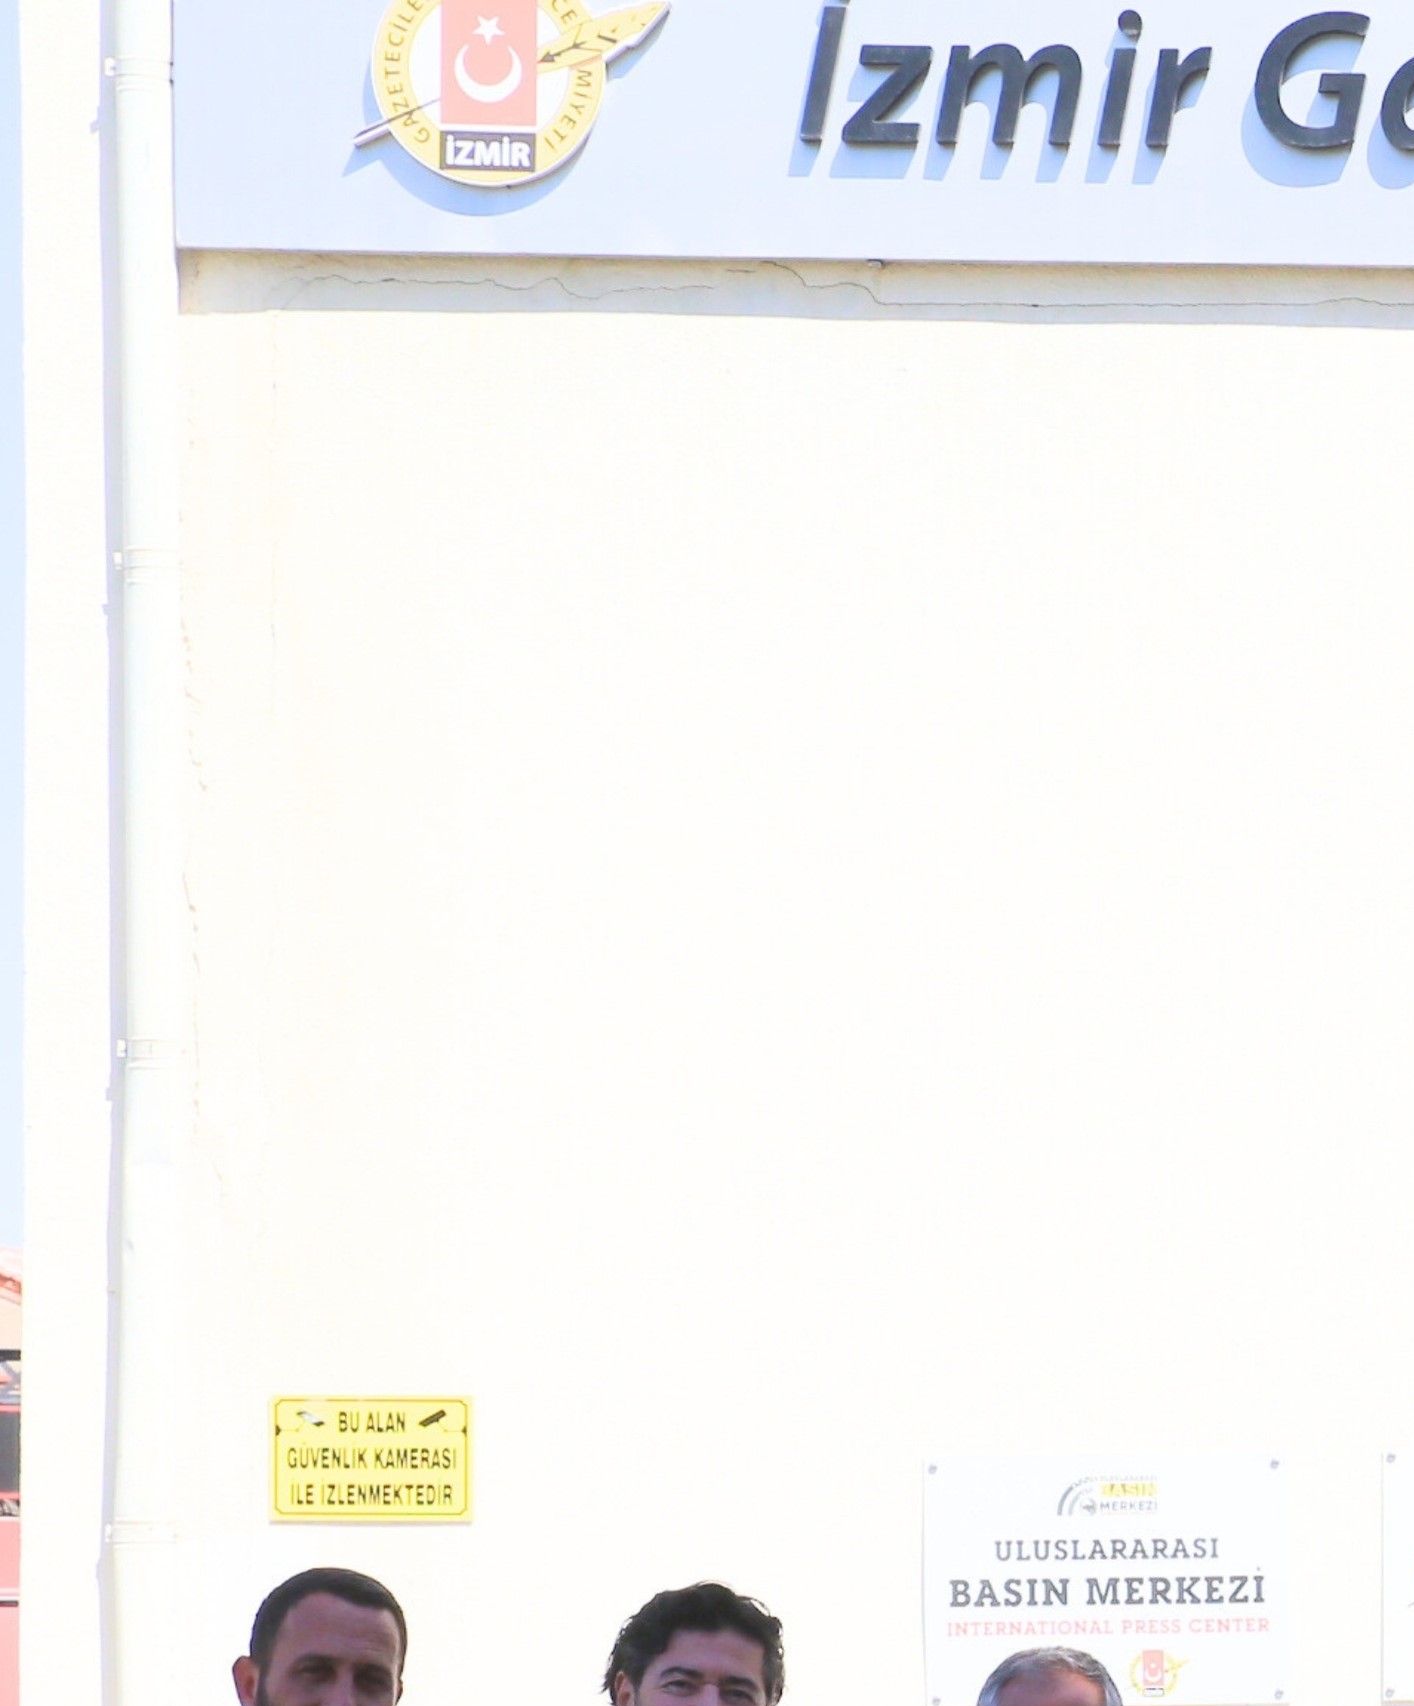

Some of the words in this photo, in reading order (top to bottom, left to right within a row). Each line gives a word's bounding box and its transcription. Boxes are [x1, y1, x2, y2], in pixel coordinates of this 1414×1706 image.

[385, 0, 431, 144] GAZETECİLE
[799, 0, 1212, 148] İzmir
[445, 134, 533, 167] İZMİR
[339, 1411, 360, 1433] BU
[366, 1411, 406, 1433] ALAN
[373, 1447, 457, 1469] KAMERASI
[994, 1537, 1220, 1562] ULUSLARARASI
[949, 1578, 1070, 1608] BASIN
[1086, 1566, 1266, 1607] MERKEZİ
[947, 1620, 1114, 1638] INTERNATIONAL
[1122, 1619, 1182, 1635] PRESS
[1188, 1617, 1271, 1634] CENTER
